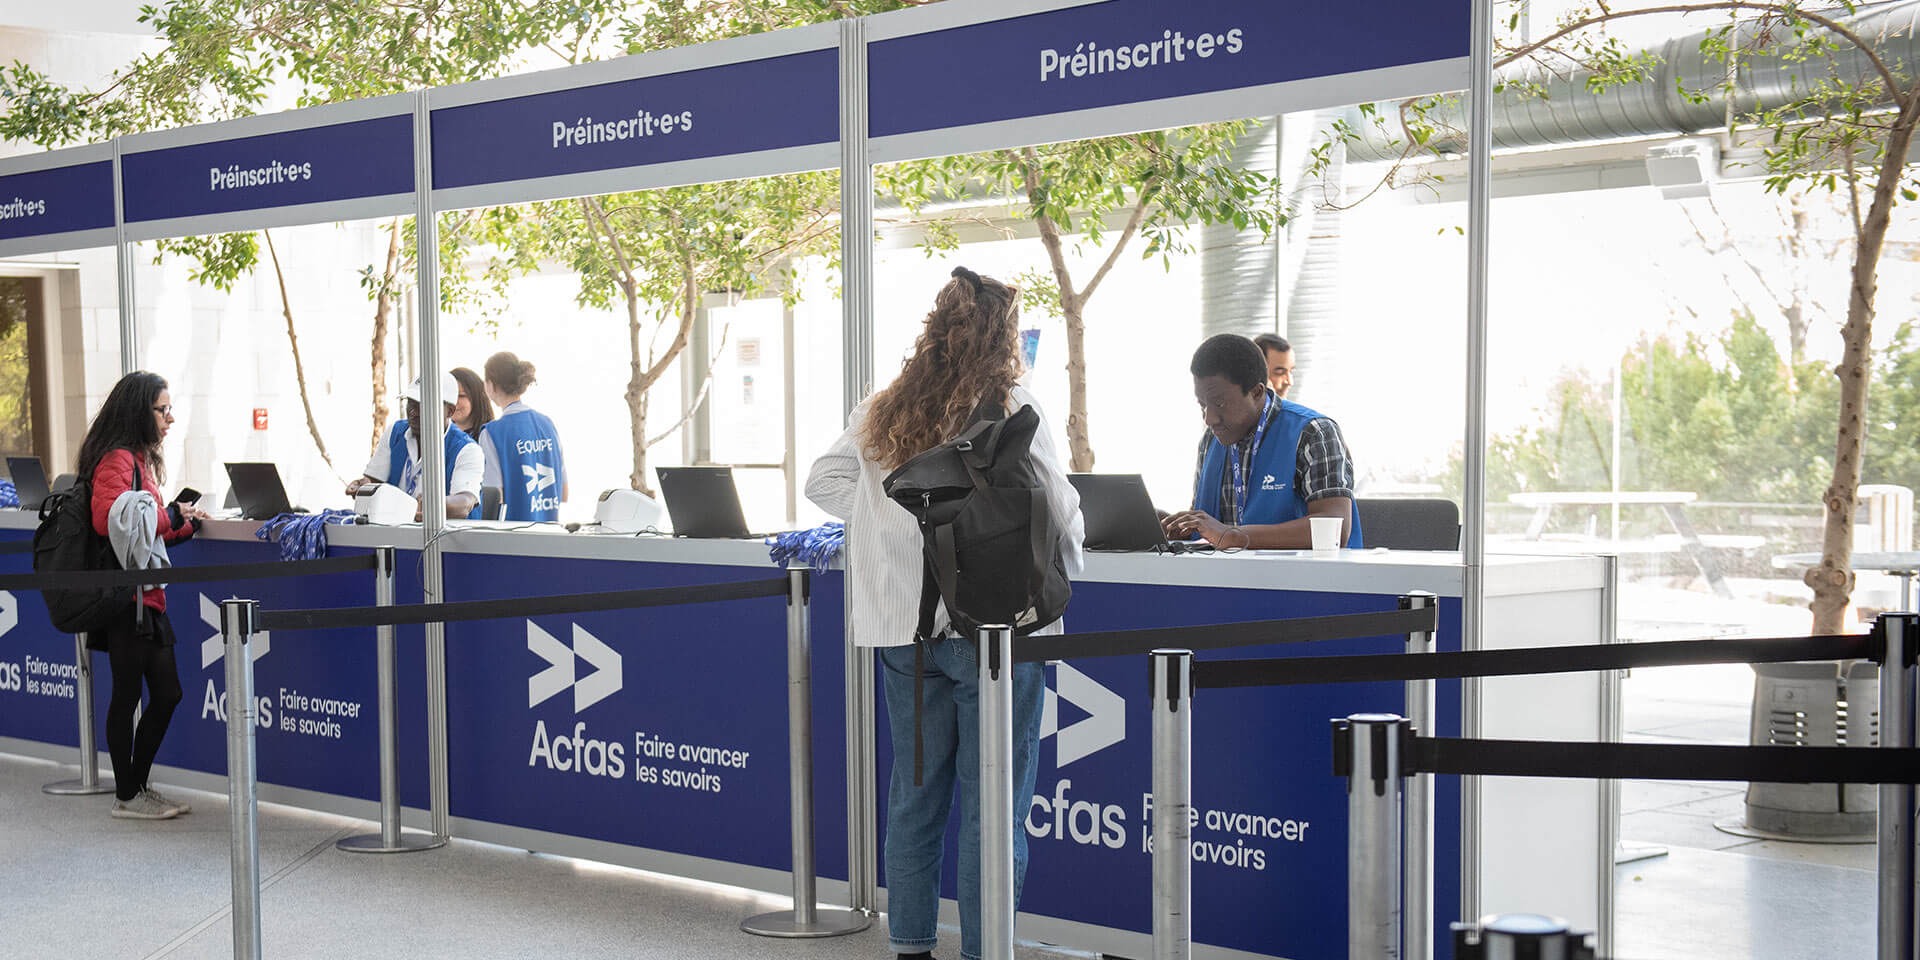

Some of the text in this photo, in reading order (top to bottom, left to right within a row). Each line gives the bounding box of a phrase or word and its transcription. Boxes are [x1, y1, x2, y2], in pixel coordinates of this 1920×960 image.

[26, 654, 78, 680] Faire avanc
[26, 674, 74, 699] les savoirs
[279, 687, 361, 719] Faire avancer
[279, 710, 342, 739] les savoirs
[528, 720, 626, 779] Acfas
[635, 732, 750, 769] Faire avancer
[635, 757, 721, 793] les savoirs
[1024, 778, 1126, 849] cfas
[1205, 809, 1310, 842] avancer
[1191, 838, 1266, 870] avoirs
